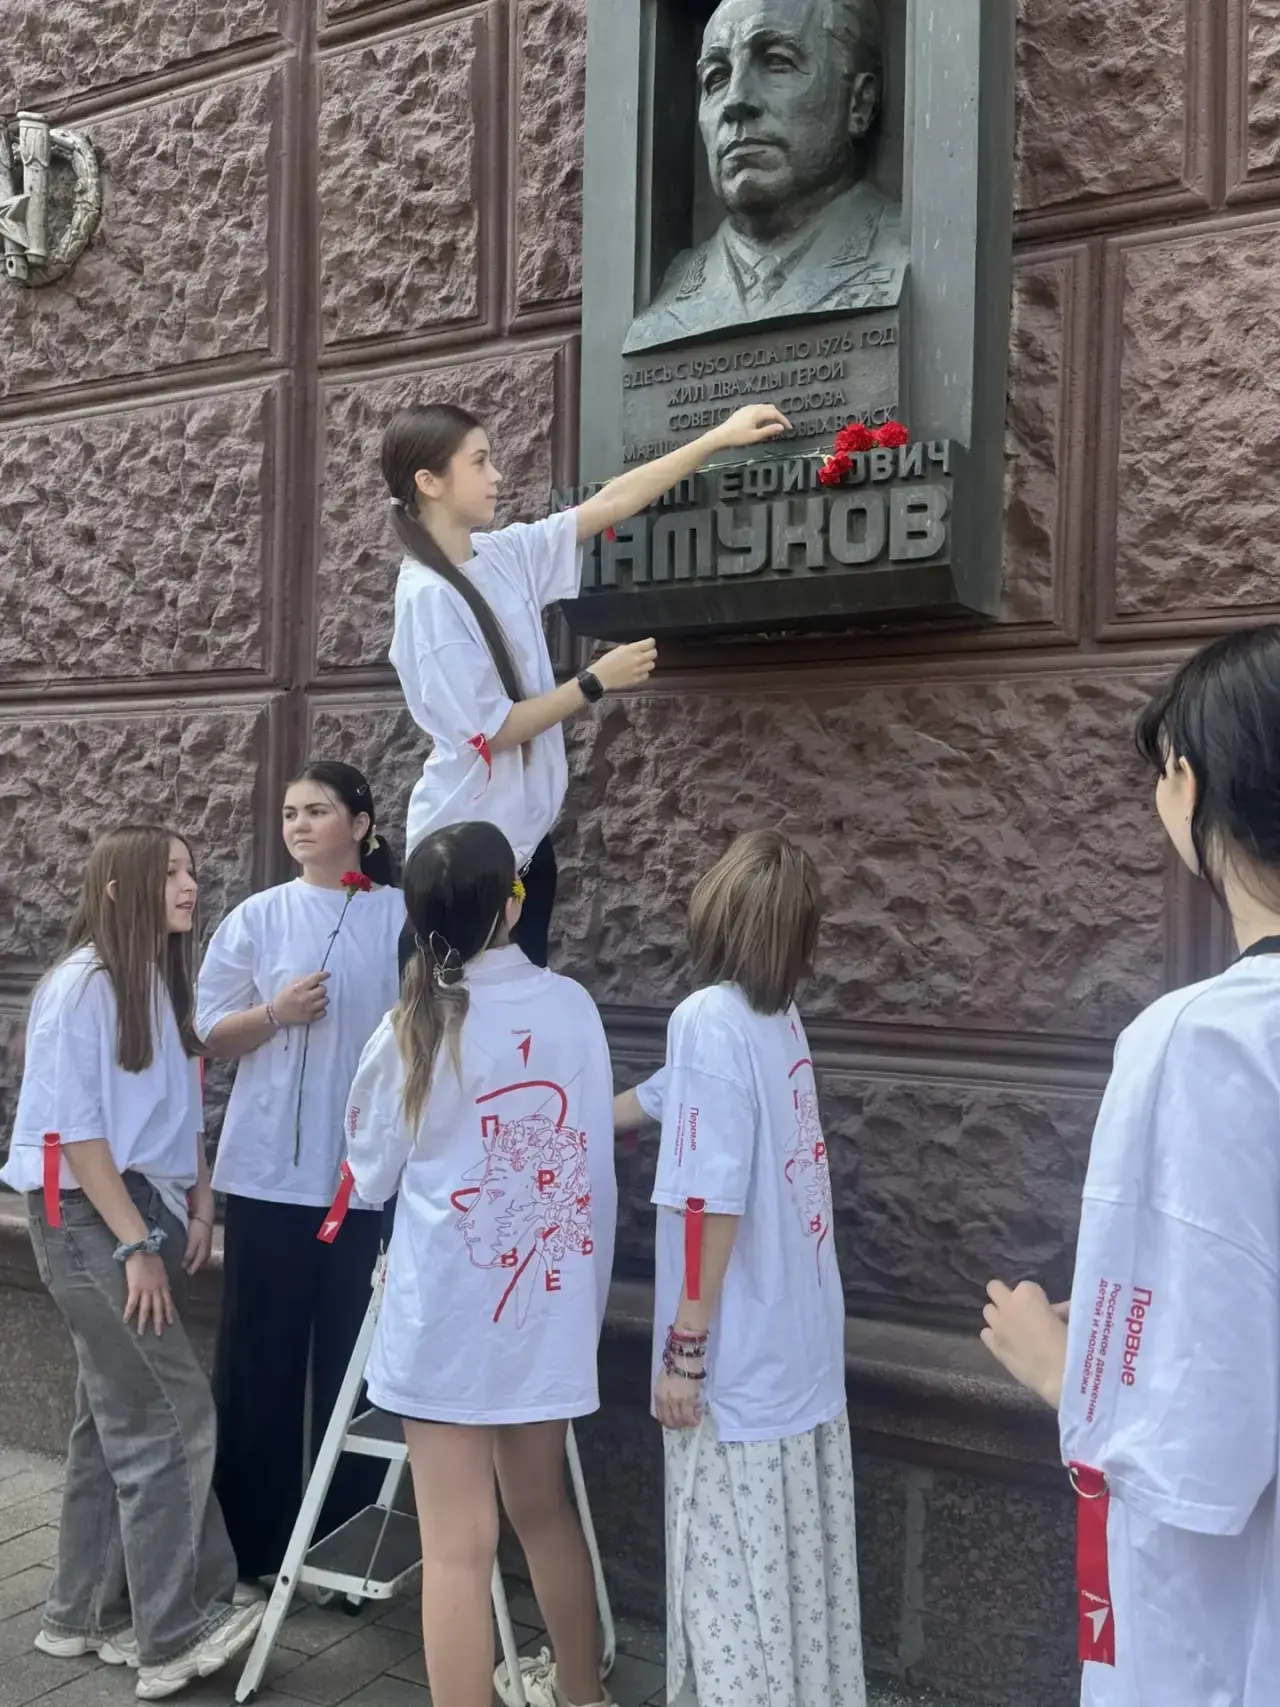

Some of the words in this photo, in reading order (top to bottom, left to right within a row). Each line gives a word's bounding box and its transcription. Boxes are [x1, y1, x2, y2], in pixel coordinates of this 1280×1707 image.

[622, 366, 672, 388] ЗДЕСЬ
[674, 363, 688, 380] С
[690, 357, 729, 378] 1950
[734, 347, 779, 369] ГОДА
[784, 342, 811, 361] ПО
[816, 333, 853, 357] 1976
[859, 328, 895, 348] ГОД
[667, 383, 705, 407] ЖИЛ
[709, 375, 782, 399] ДВАЖДЫ
[780, 388, 848, 414] СОЮЗА
[1094, 1278, 1108, 1316] детей
[1099, 1283, 1122, 1356] Российское
[1121, 1287, 1152, 1386] Первые
[1086, 1358, 1105, 1423] движение
